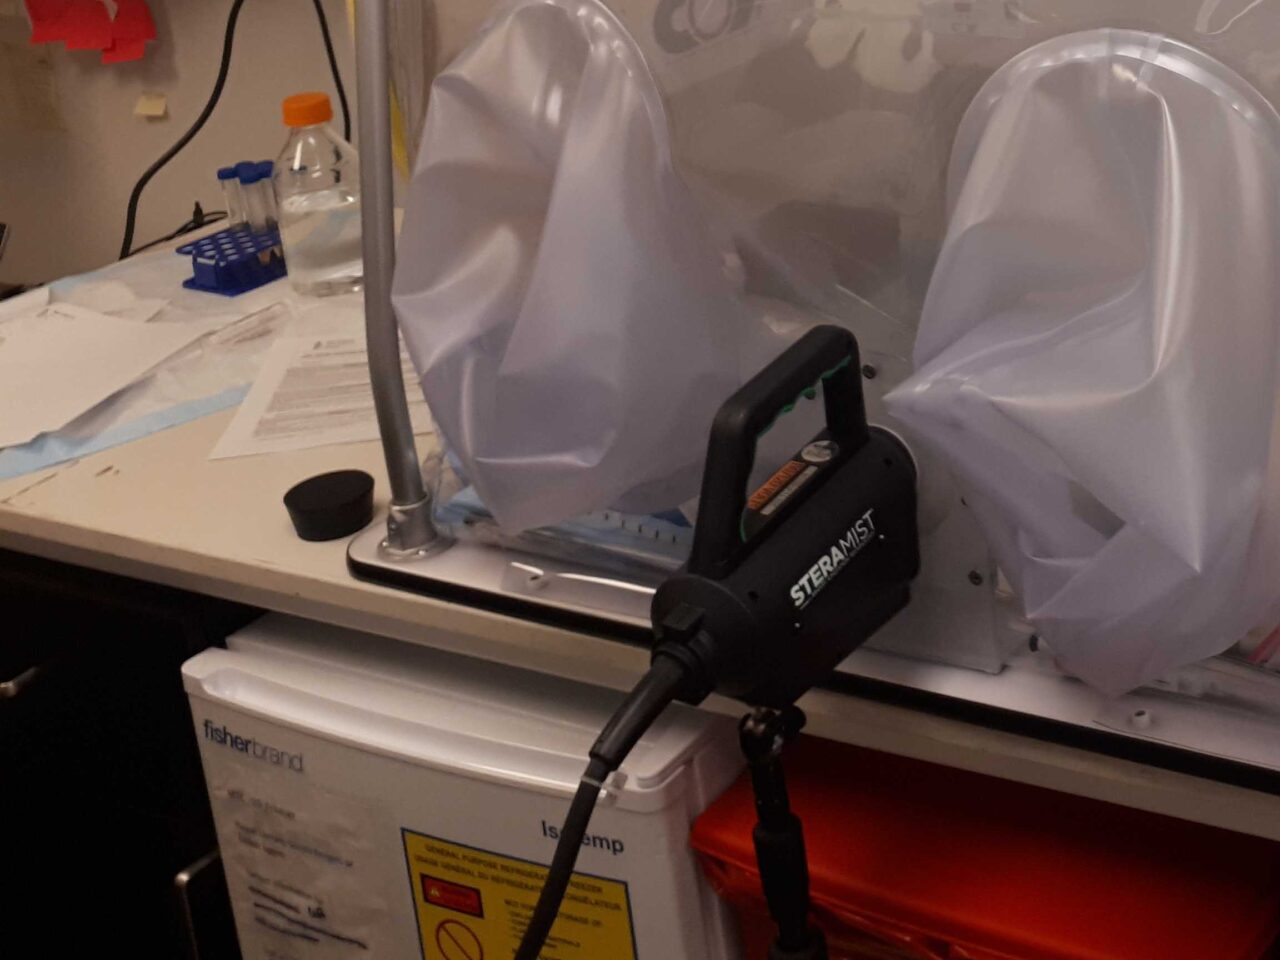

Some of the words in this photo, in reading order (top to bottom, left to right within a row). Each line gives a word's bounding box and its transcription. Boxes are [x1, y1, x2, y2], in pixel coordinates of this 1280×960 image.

[790, 508, 875, 607] STERAMIST
[203, 719, 304, 773] fisherbrand
[541, 820, 624, 855] Isemp
